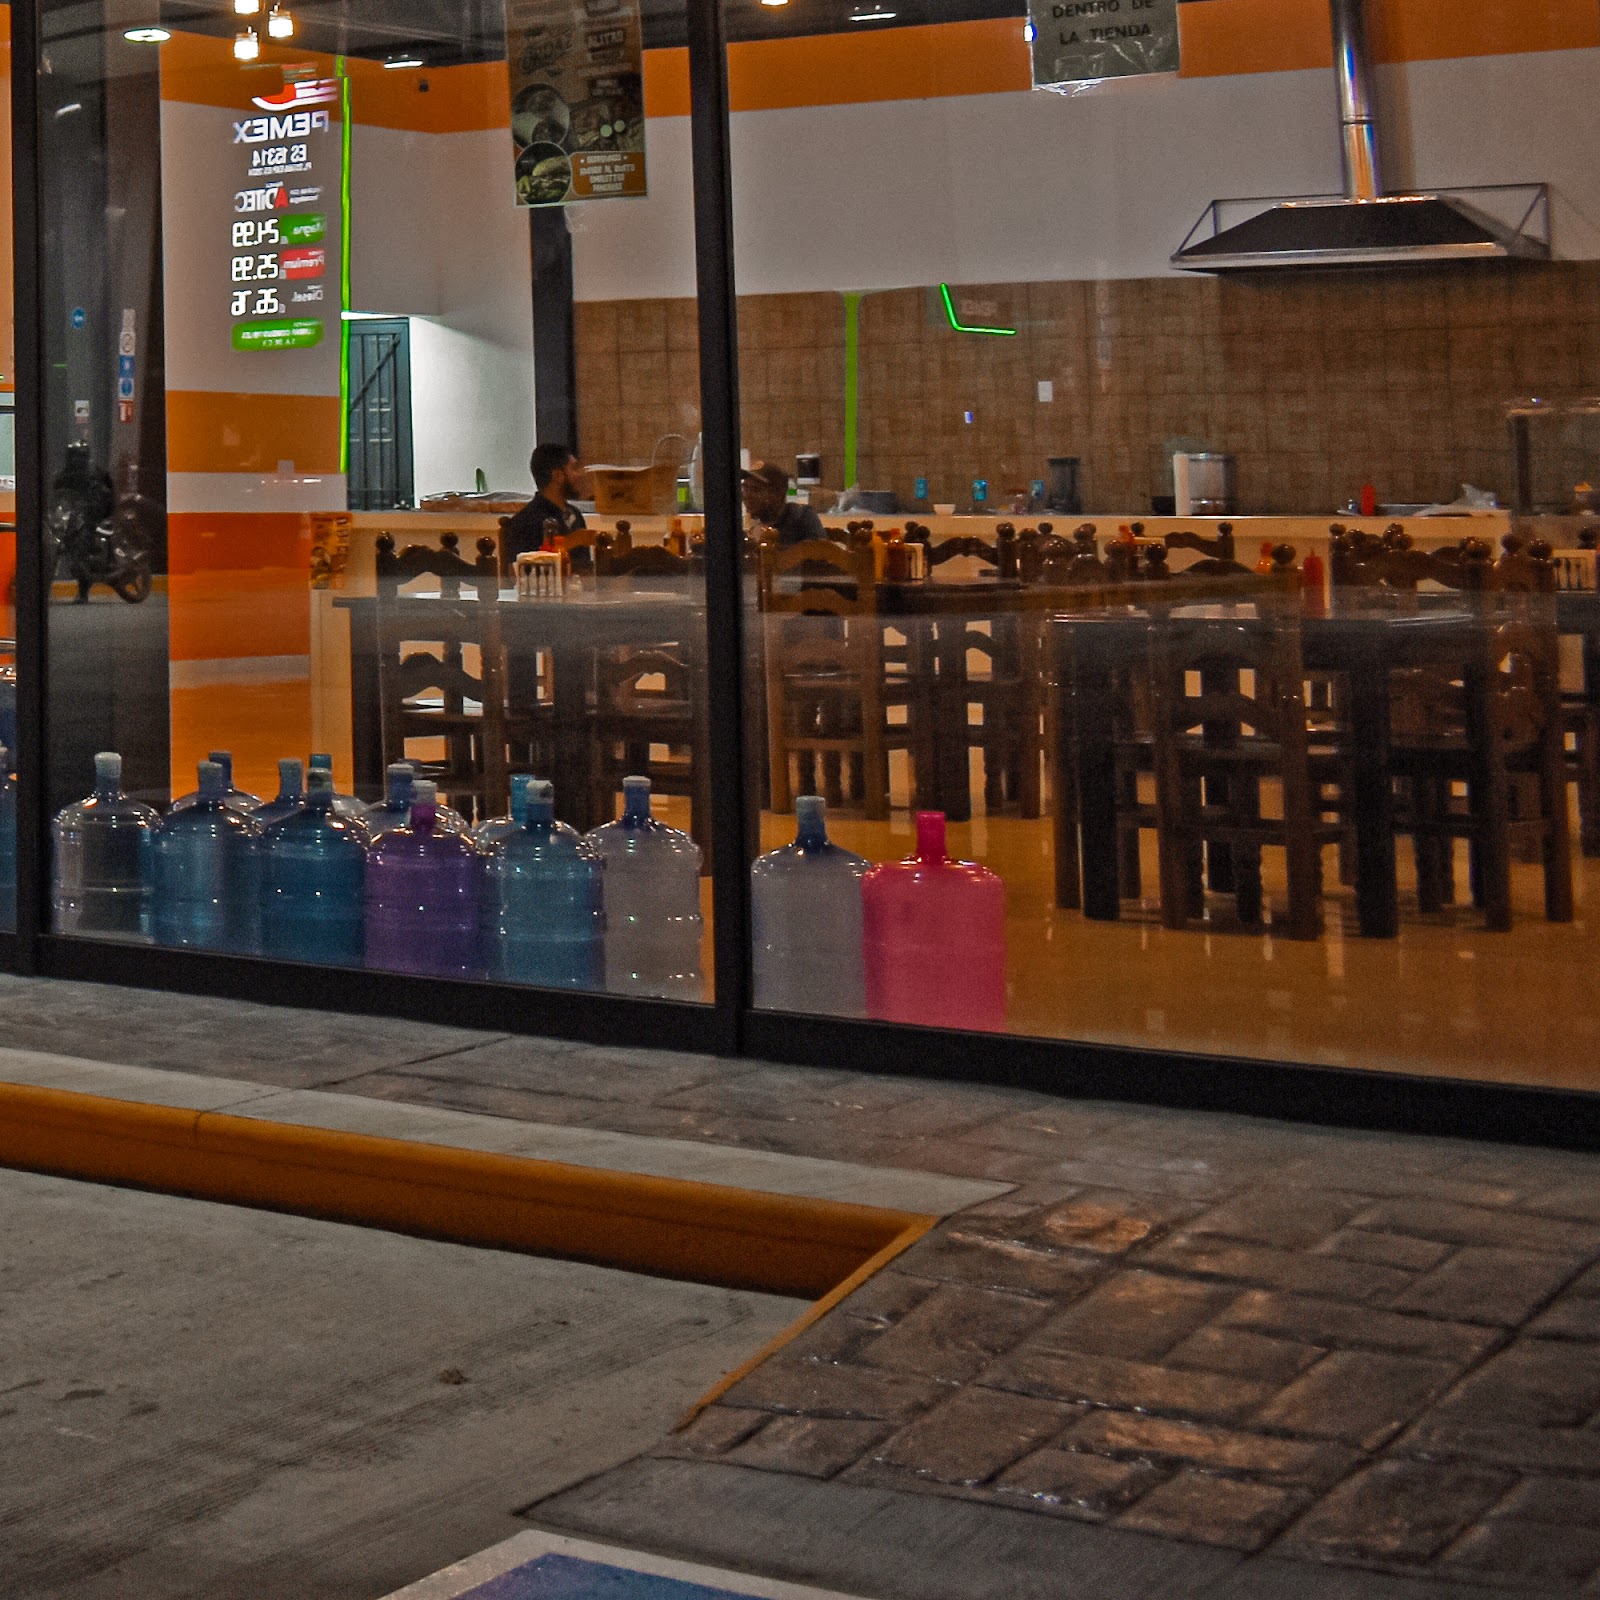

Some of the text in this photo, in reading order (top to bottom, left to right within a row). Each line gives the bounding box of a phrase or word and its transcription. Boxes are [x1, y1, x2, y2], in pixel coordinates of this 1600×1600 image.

[1052, 0, 1120, 19] DENTRO
[1059, 24, 1152, 45] LA TIENDA
